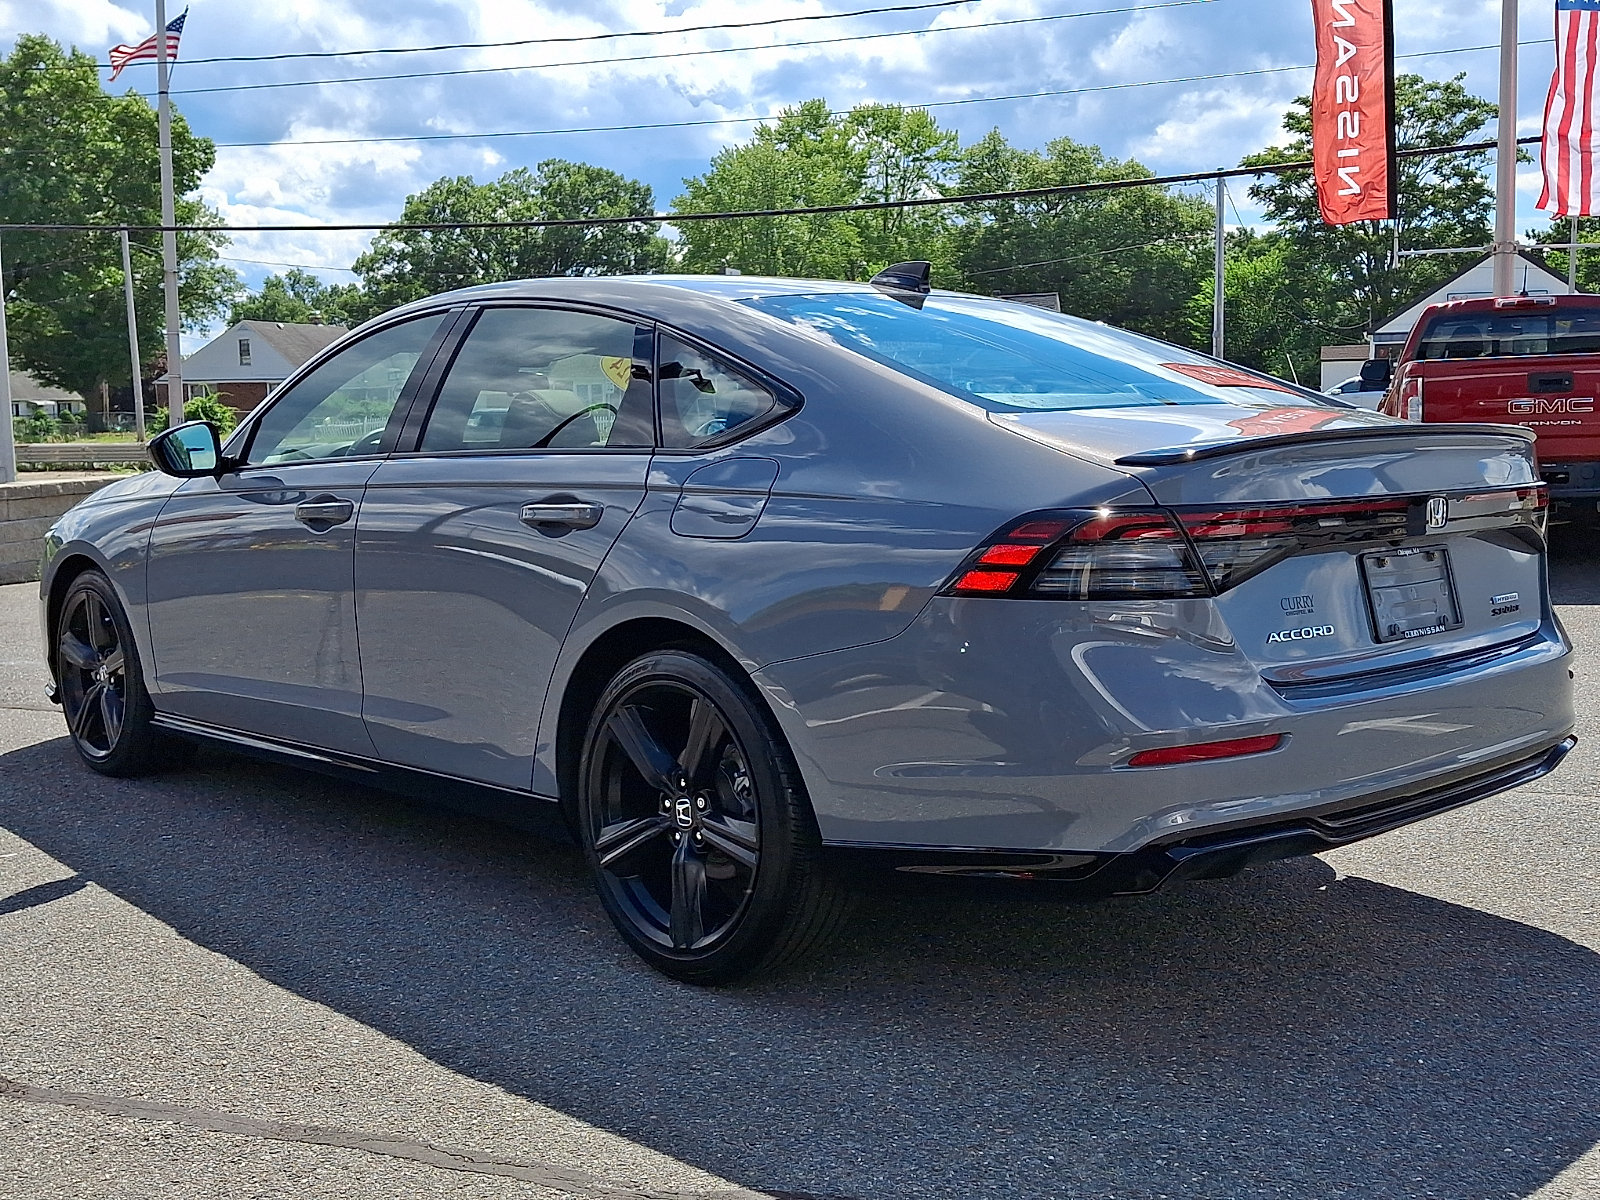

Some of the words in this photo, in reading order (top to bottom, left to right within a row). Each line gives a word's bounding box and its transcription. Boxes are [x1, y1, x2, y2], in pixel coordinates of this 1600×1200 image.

[1507, 397, 1594, 414] GMC
[1281, 594, 1314, 610] CURRY
[1267, 625, 1334, 644] ACCORD
